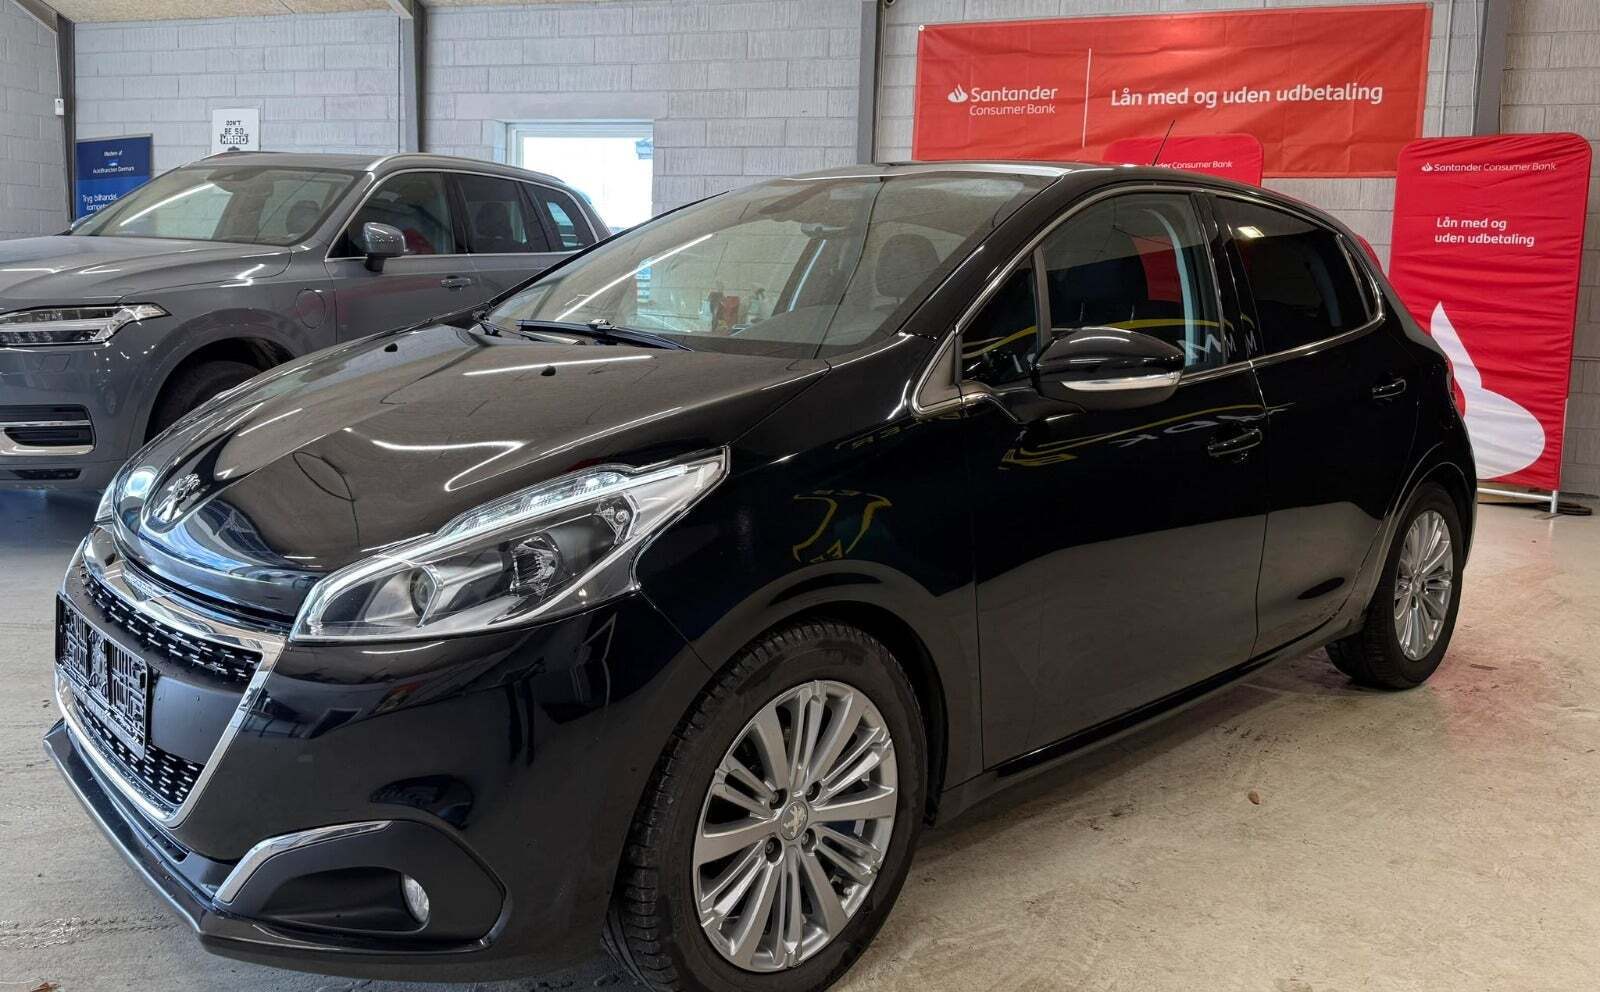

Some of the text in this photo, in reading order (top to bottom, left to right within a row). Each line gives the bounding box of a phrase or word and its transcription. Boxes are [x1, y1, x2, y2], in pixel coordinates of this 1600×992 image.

[970, 86, 1058, 103] Santander
[1111, 82, 1383, 109] Lån med og uden udbetaling
[969, 103, 1056, 116] Consumer Bank
[224, 127, 244, 135] BE SO
[220, 133, 249, 145] HARD
[1172, 161, 1211, 169] Consumer
[1212, 160, 1233, 168] Bank
[1434, 162, 1557, 172] Santander Consumer Bank
[1436, 216, 1507, 231] Lån med og
[1434, 233, 1535, 247] uden udbetaling
